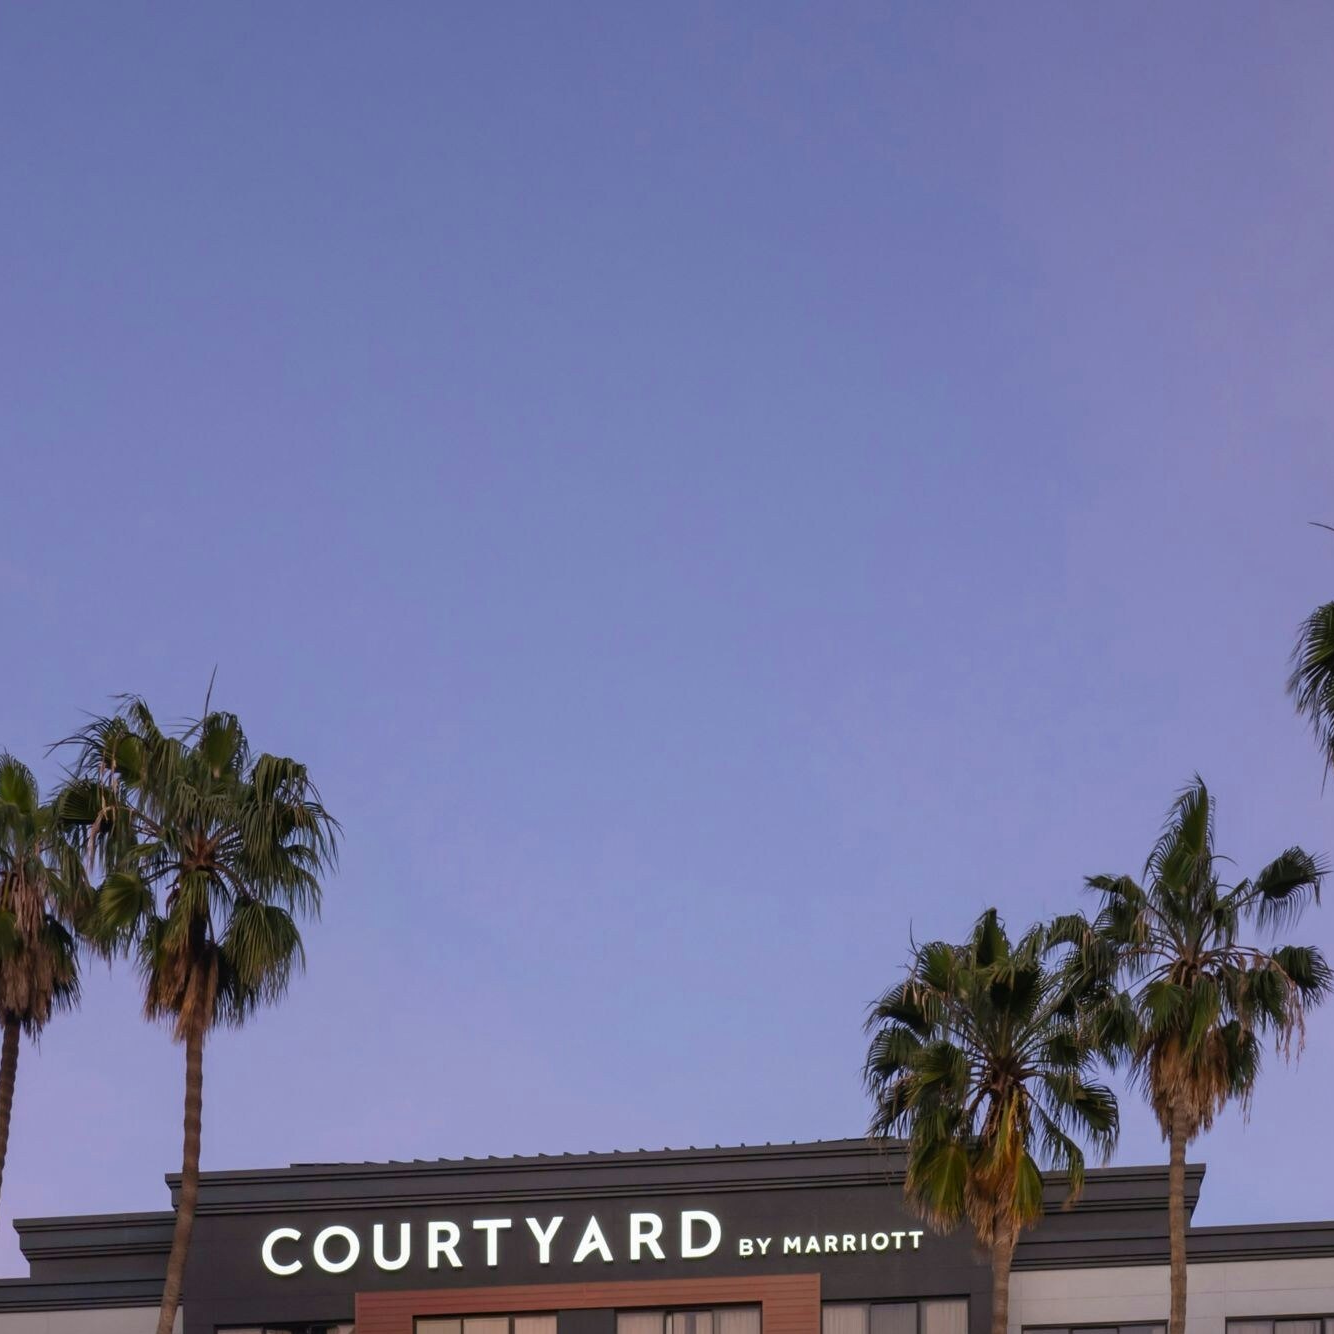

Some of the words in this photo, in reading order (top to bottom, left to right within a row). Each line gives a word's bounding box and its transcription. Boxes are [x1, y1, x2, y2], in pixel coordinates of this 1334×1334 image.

[261, 1209, 722, 1276] COURTYARD
[738, 1238, 771, 1256] BY
[783, 1231, 924, 1254] MARRIOTT
